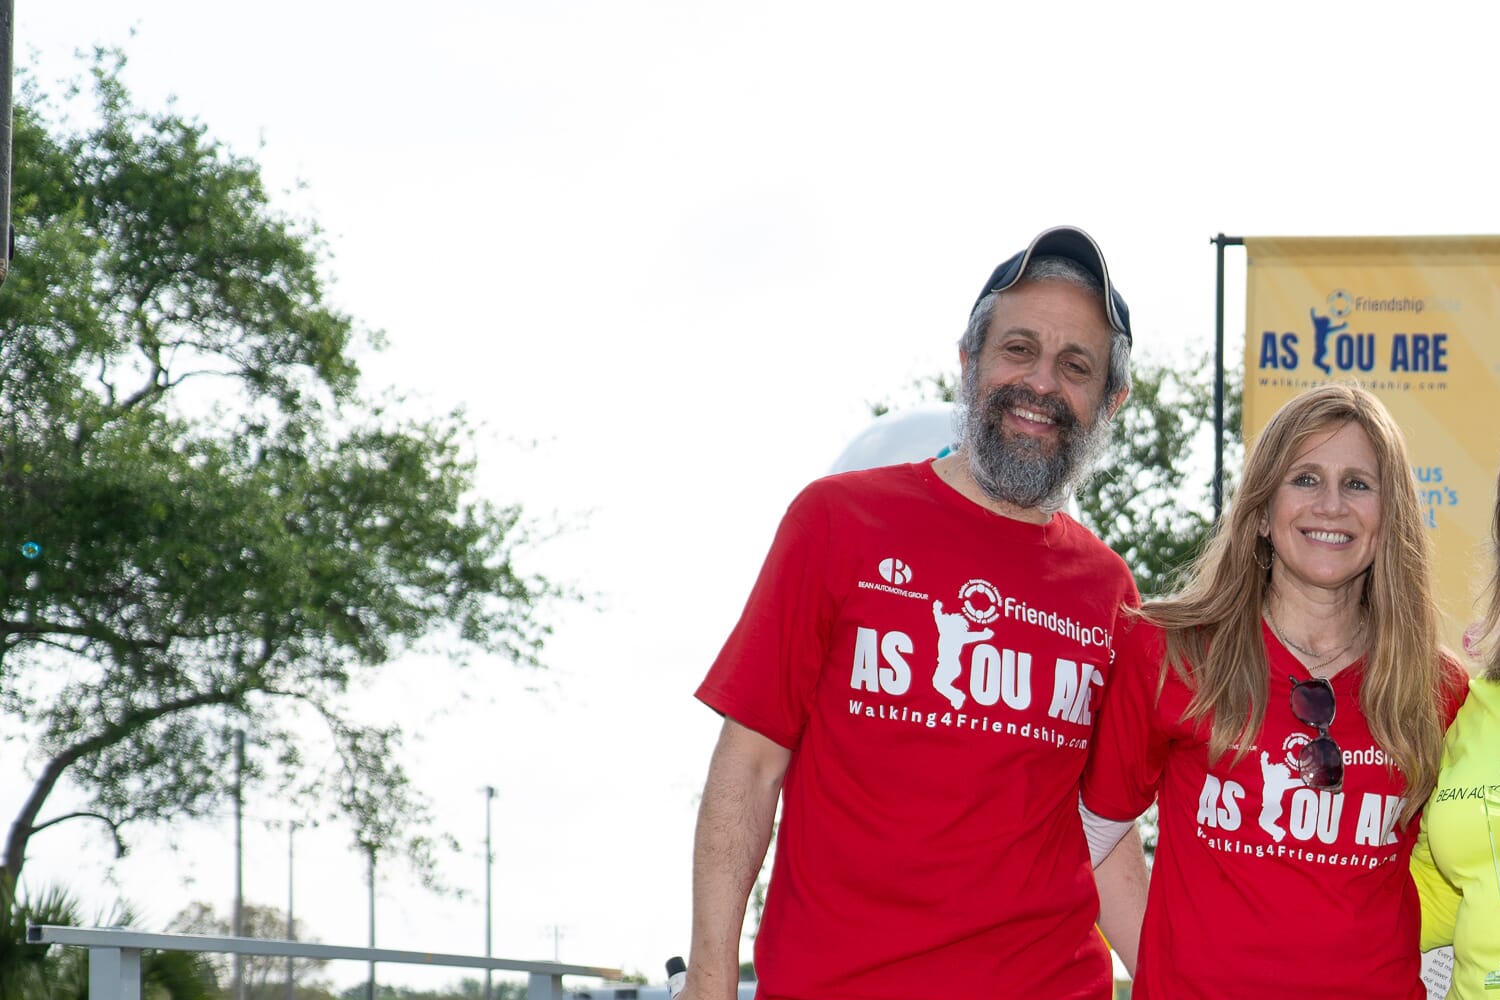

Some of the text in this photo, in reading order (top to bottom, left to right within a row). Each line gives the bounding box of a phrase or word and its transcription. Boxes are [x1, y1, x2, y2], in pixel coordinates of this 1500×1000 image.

[1259, 331, 1299, 370] AS
[1390, 333, 1448, 372] ARE
[850, 626, 914, 696] AS
[1197, 773, 1246, 832] AS
[1436, 788, 1467, 803] BEAN
